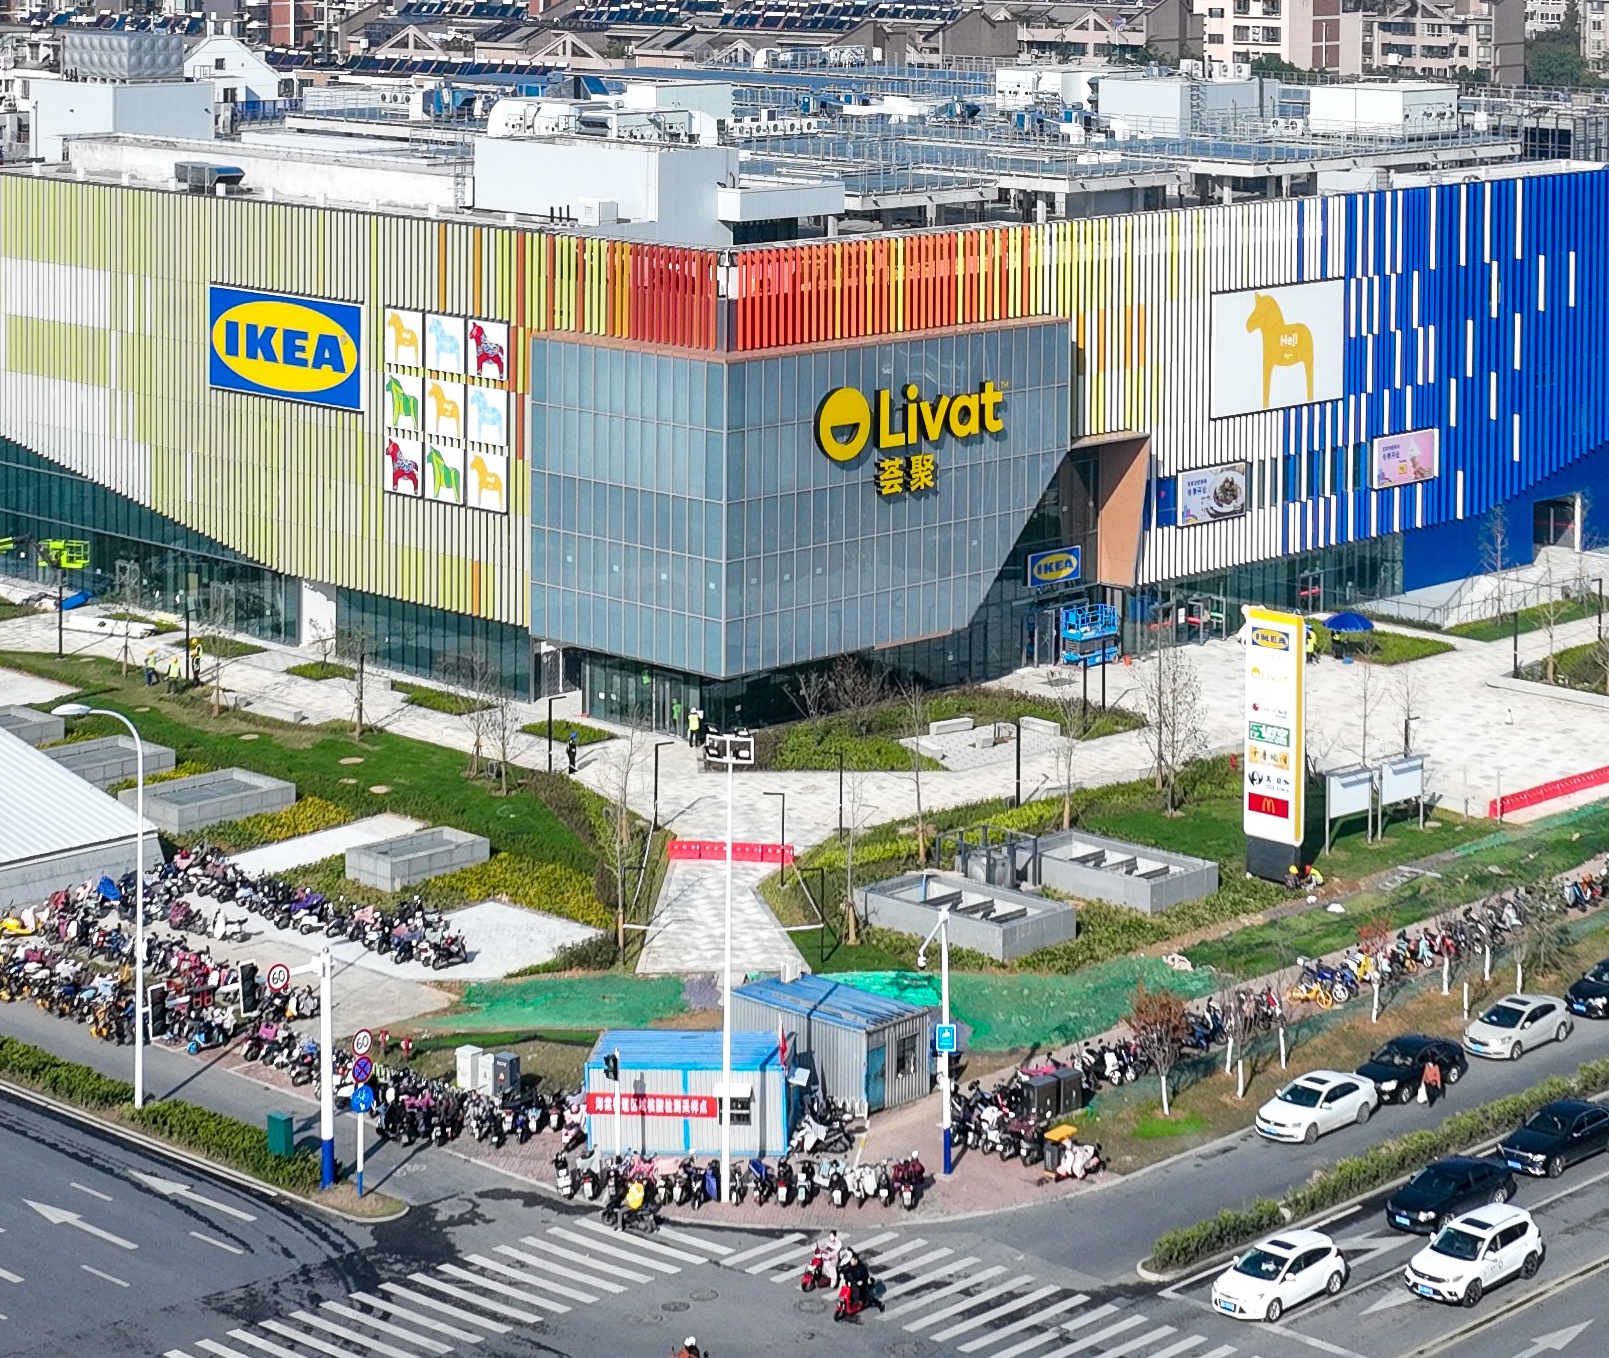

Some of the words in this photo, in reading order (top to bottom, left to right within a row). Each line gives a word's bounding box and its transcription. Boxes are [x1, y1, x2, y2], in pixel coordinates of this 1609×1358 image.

[224, 319, 348, 374] IKEA
[878, 380, 1005, 449] Livat
[878, 452, 936, 496] 荟聚
[1037, 558, 1075, 575] IKEA
[271, 969, 286, 985] 60
[356, 1035, 369, 1050] 60
